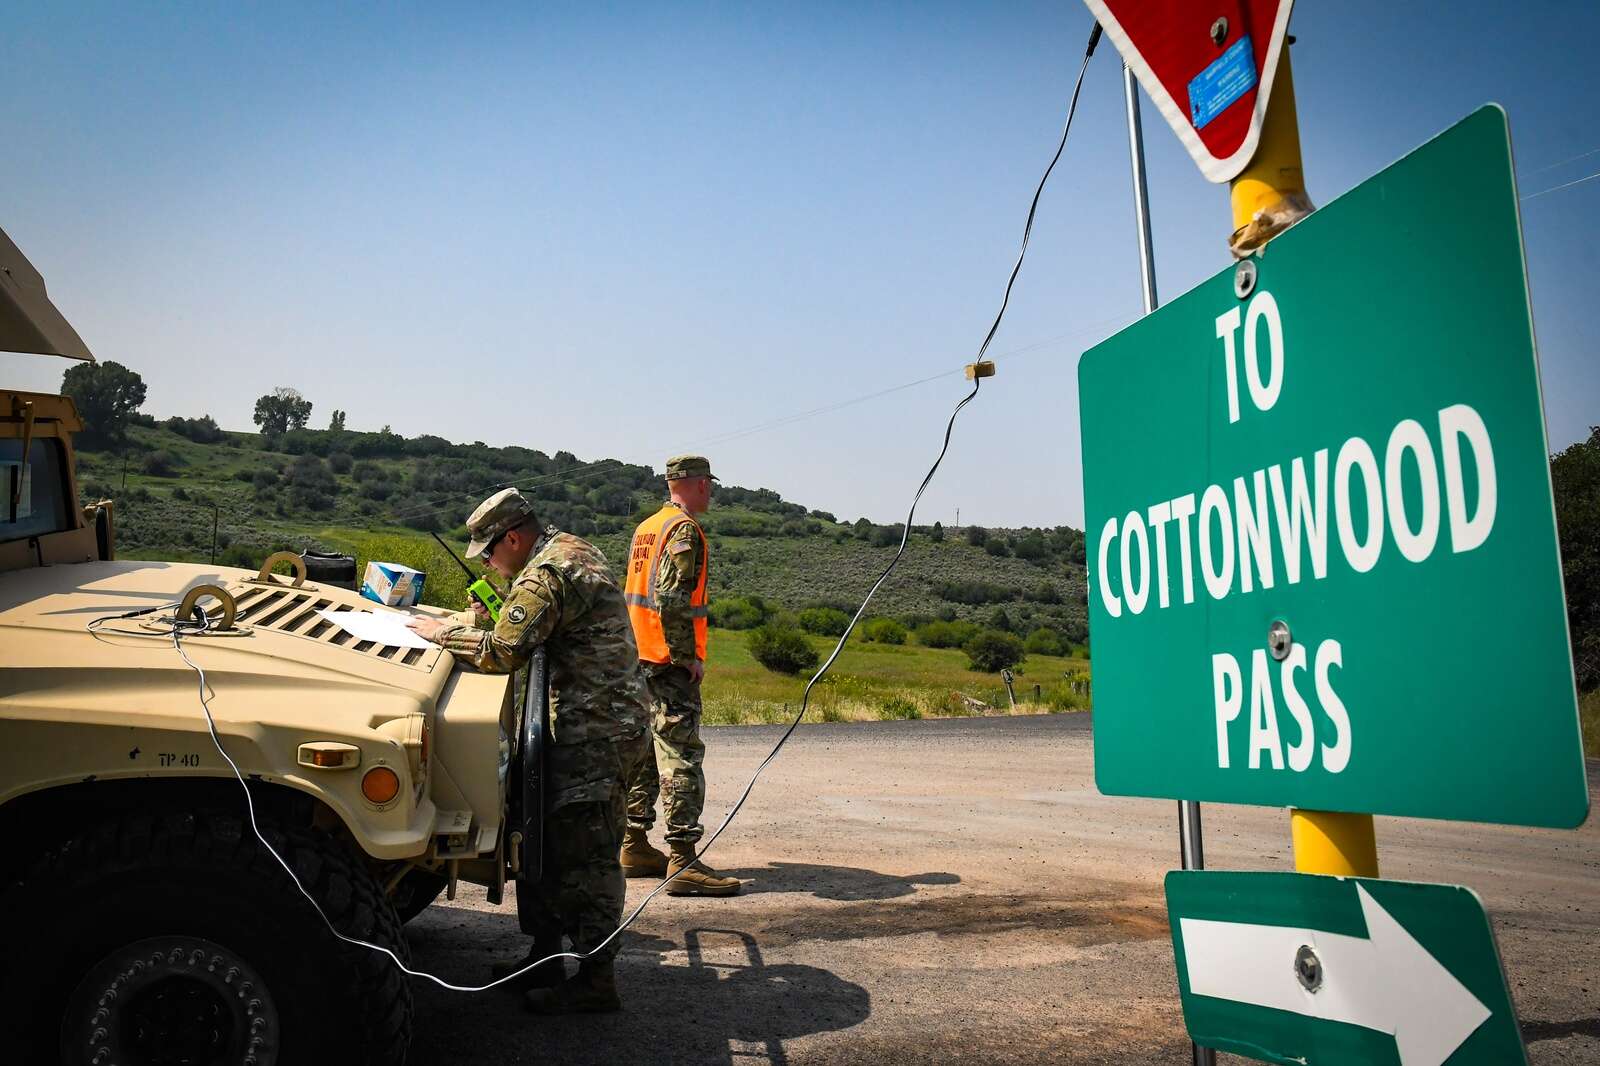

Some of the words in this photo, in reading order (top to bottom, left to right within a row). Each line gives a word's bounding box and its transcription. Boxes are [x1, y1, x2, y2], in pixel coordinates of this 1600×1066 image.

[1216, 291, 1284, 424] TO
[1098, 404, 1498, 618] COTTONWOOD
[158, 753, 176, 768] TP
[180, 753, 200, 768] 40
[1212, 639, 1352, 774] PASS
